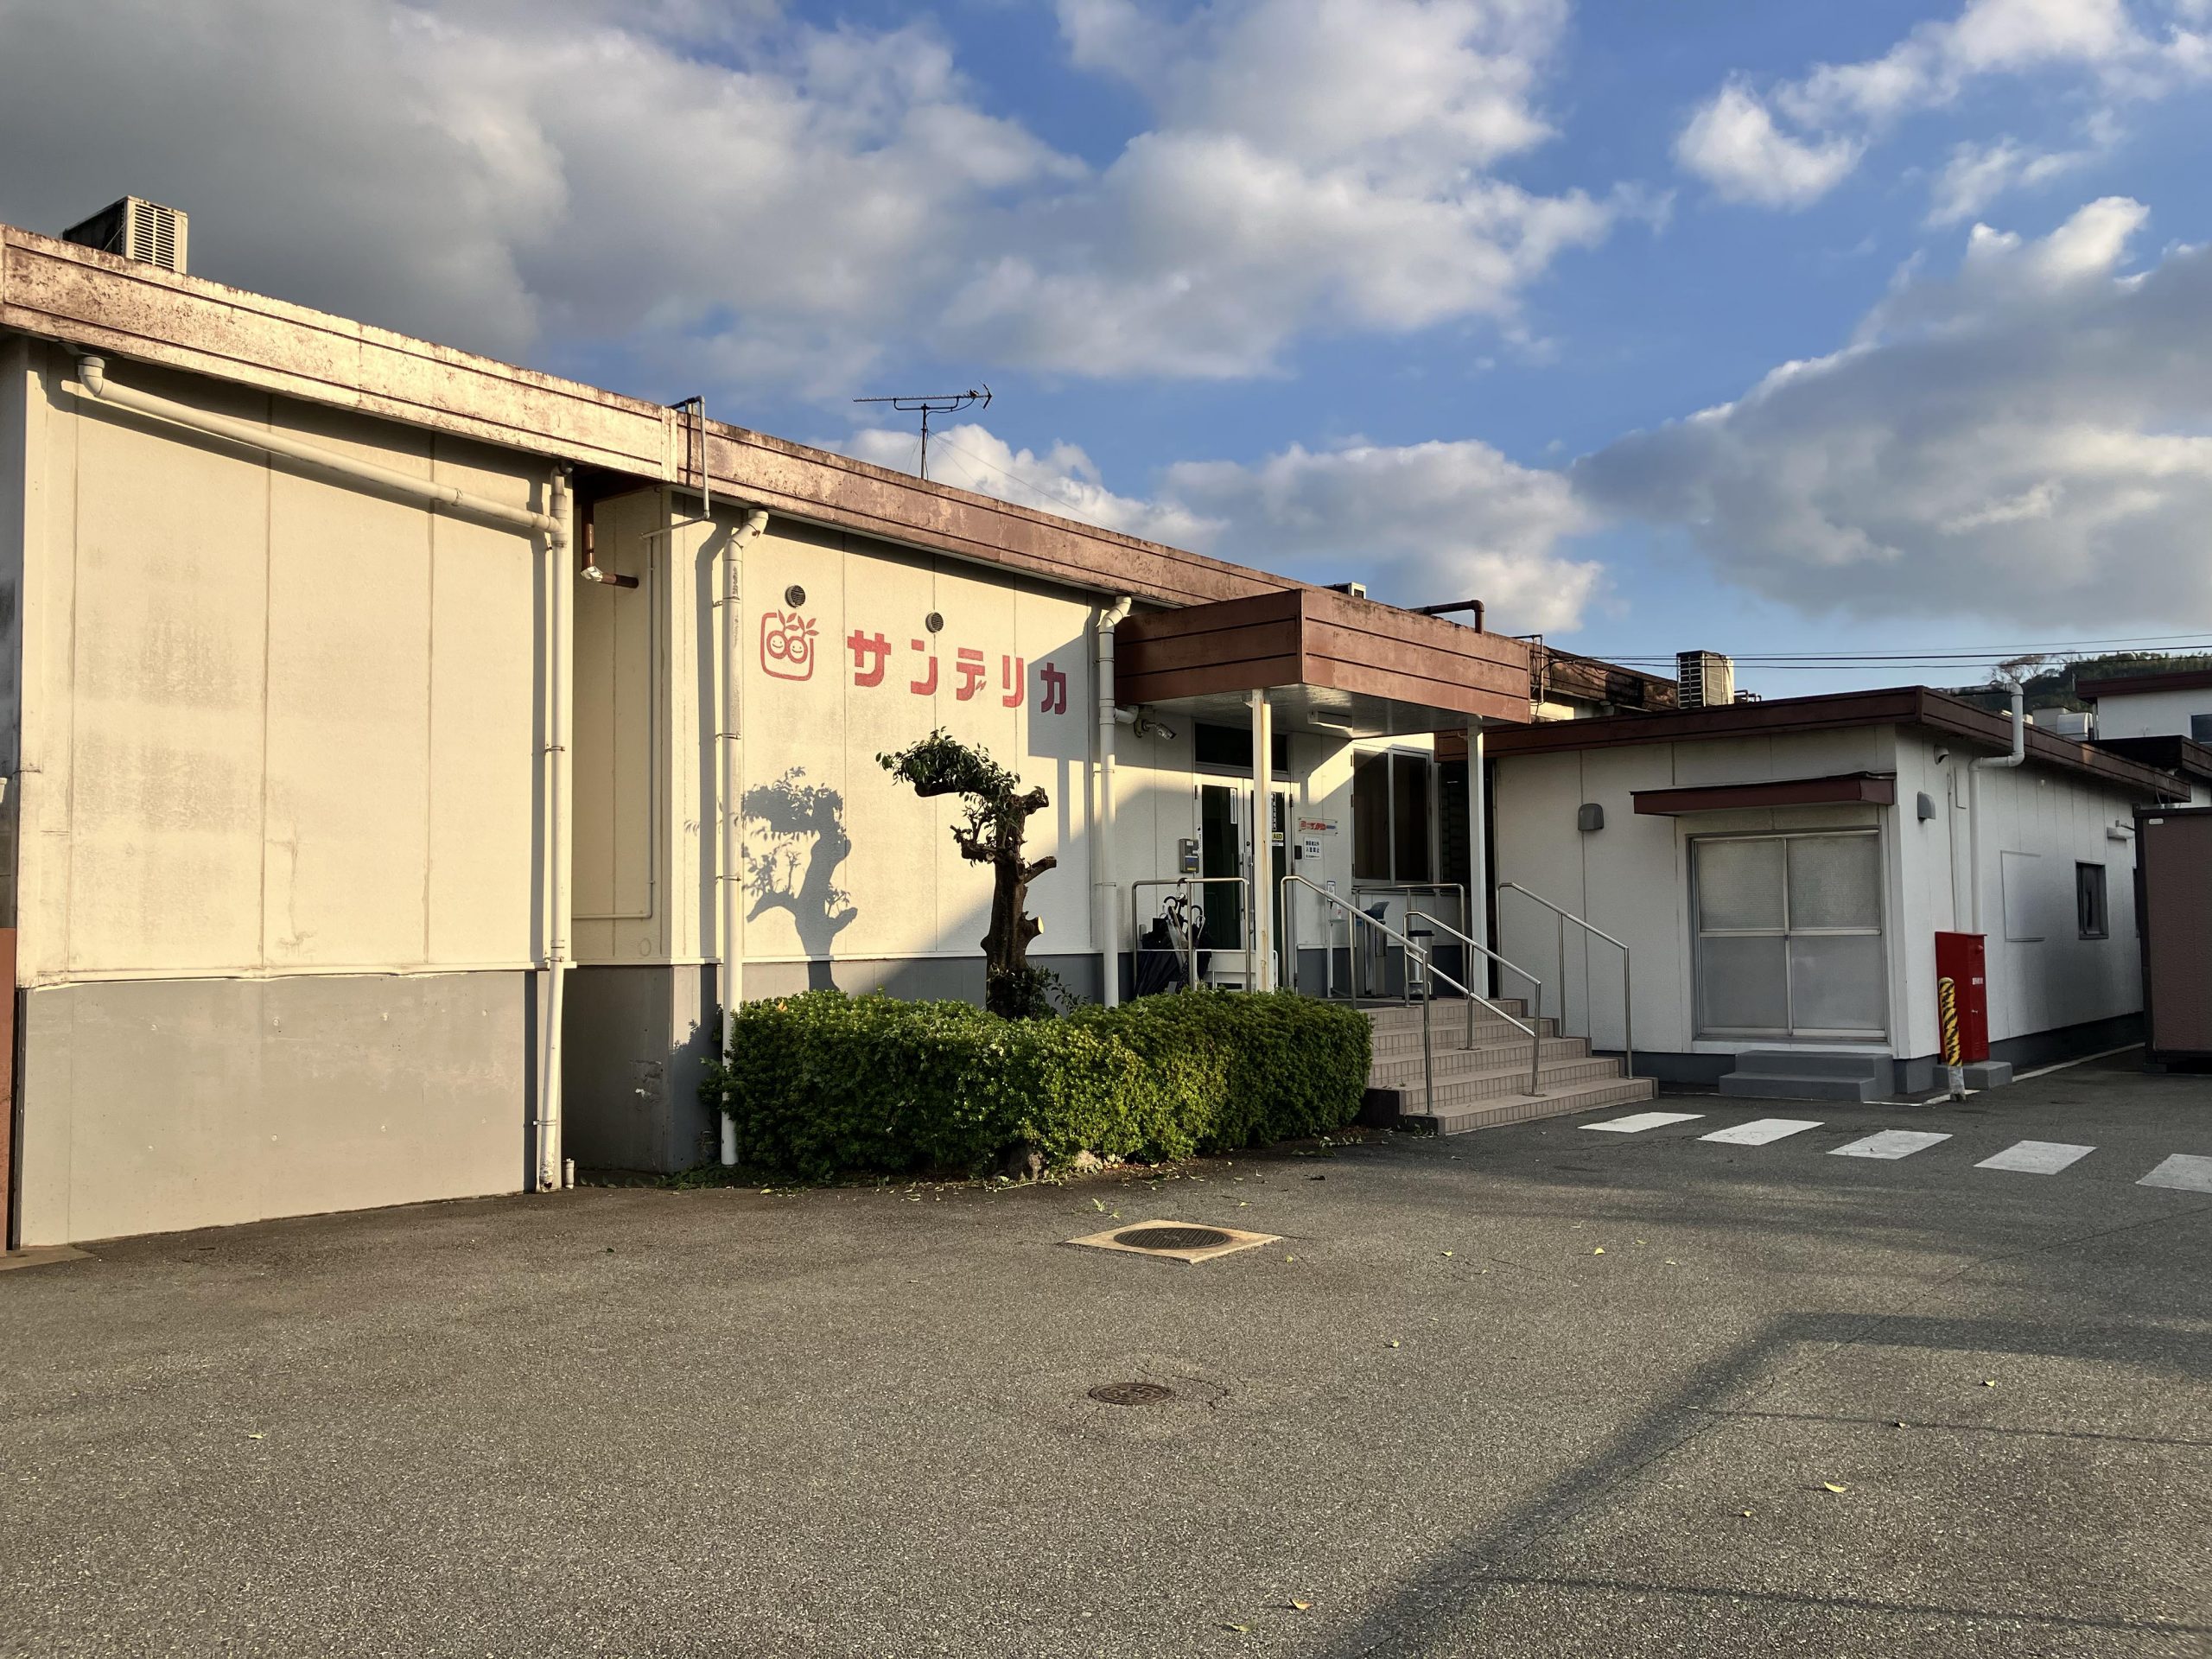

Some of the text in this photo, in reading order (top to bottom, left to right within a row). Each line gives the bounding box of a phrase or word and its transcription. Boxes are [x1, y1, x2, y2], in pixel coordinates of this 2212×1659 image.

[847, 629, 1067, 715] サンデリカ
